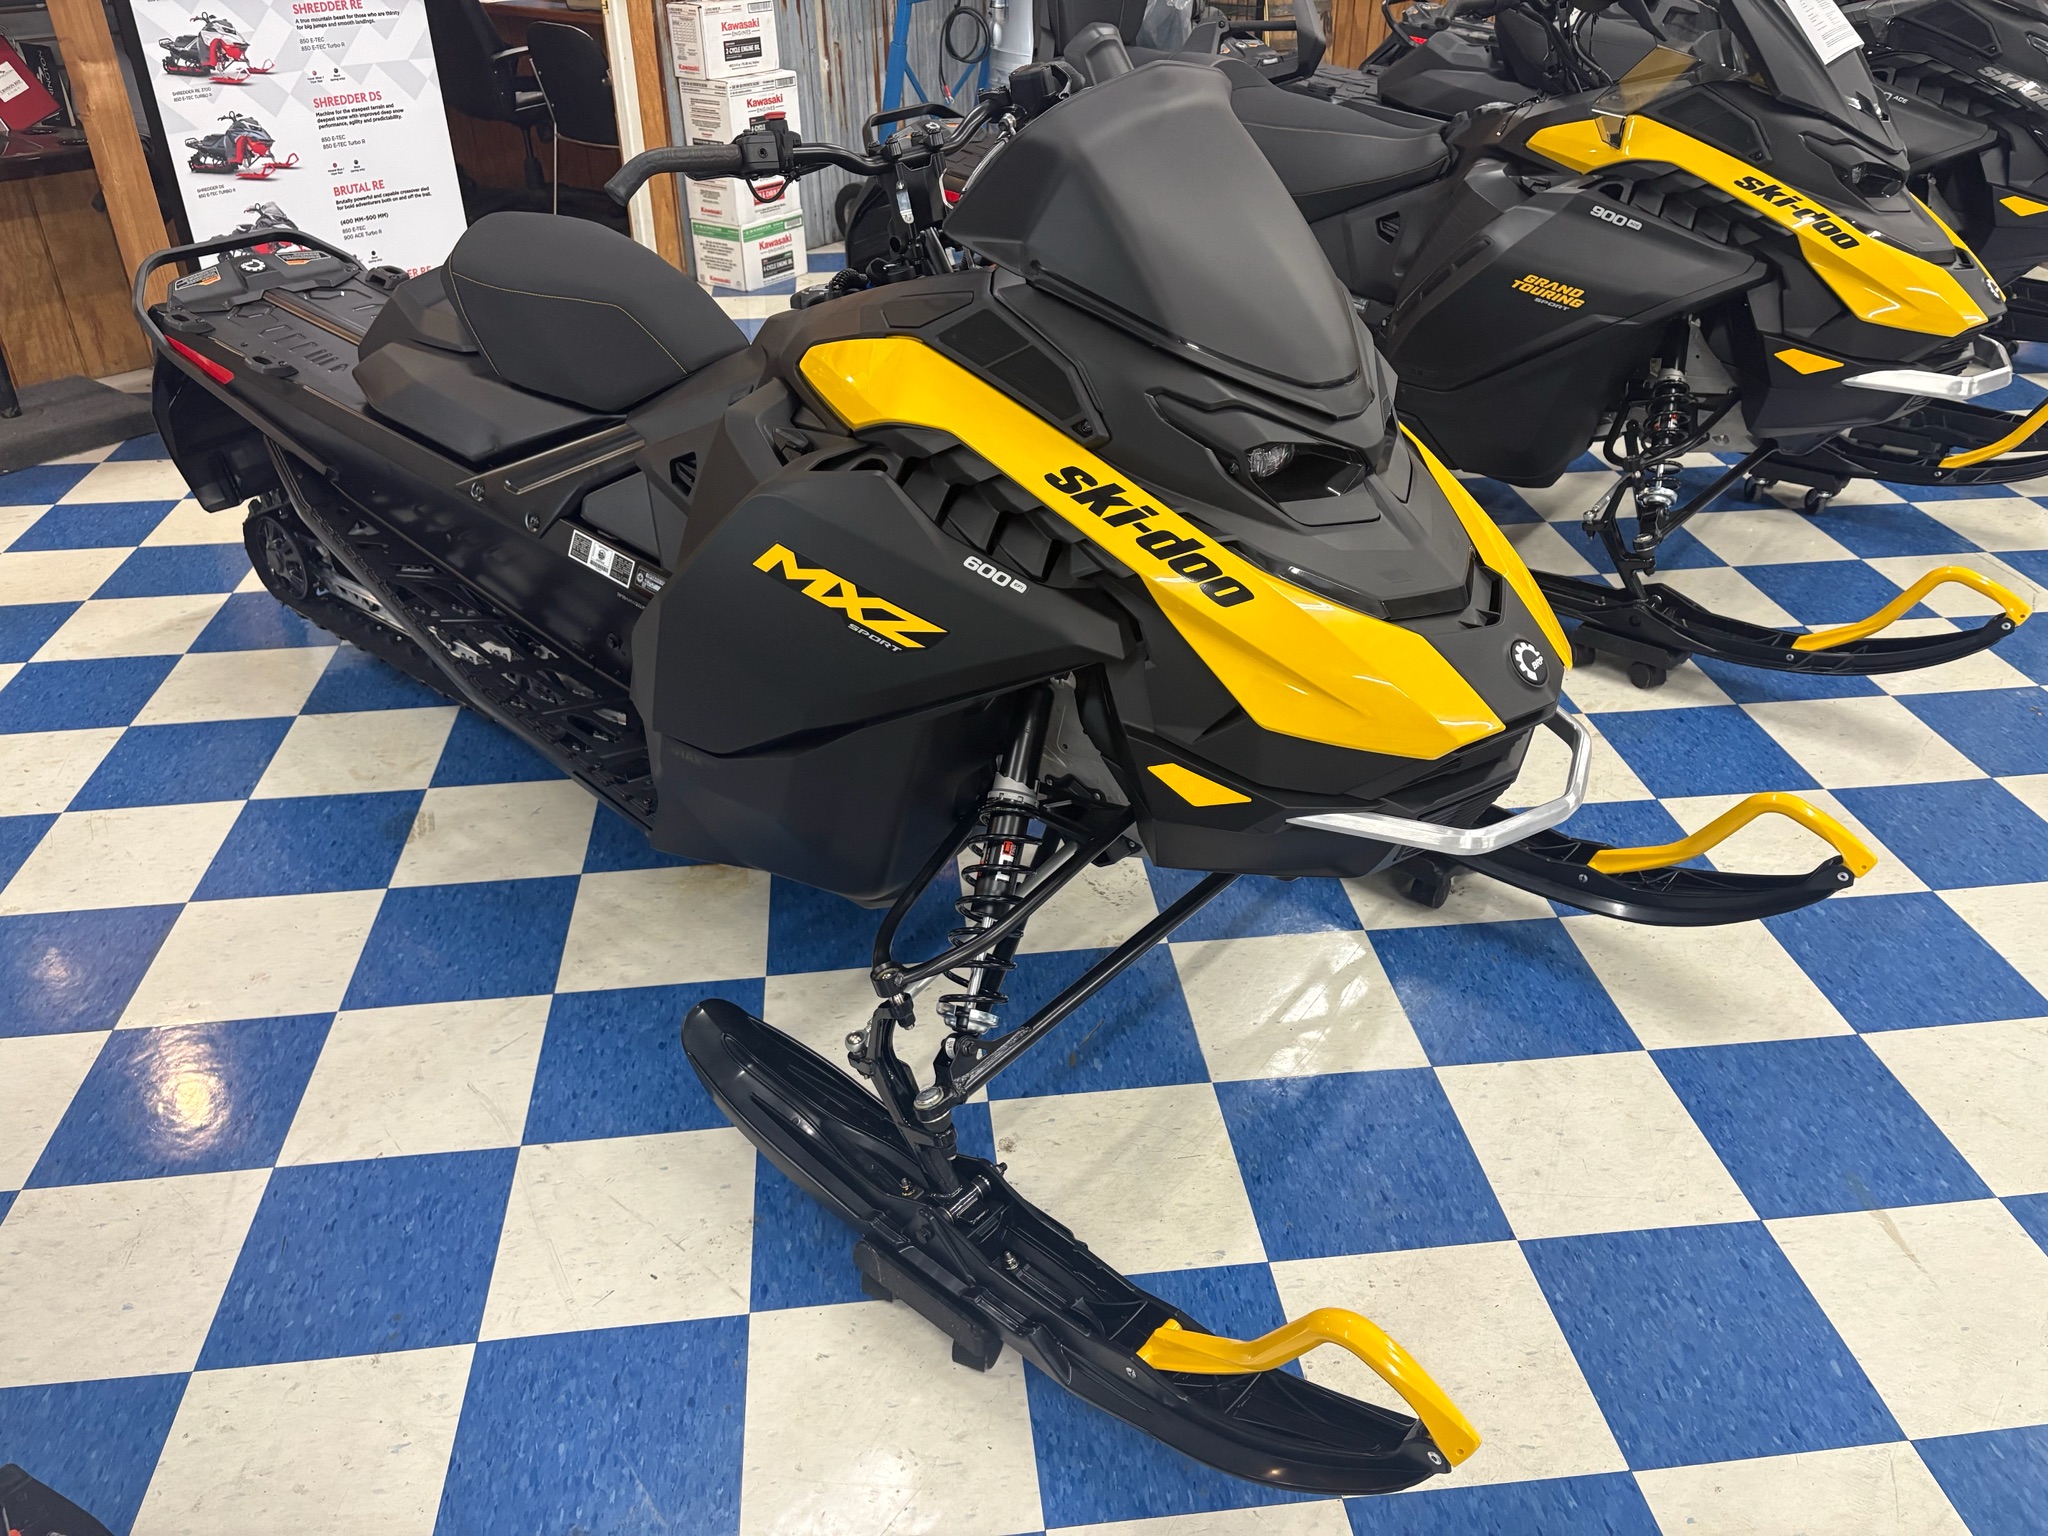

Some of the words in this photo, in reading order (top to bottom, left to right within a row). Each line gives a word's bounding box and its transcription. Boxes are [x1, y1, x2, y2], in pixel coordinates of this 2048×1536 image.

[293, 0, 348, 14] SHREDDER
[350, 0, 363, 9] RE
[721, 18, 760, 31] Kawasaki
[313, 92, 367, 108] SHREDDER
[369, 91, 382, 101] DS
[746, 93, 784, 108] Kawasaki
[1893, 95, 1909, 104] ACE
[333, 182, 371, 197] BRUTAL
[372, 179, 385, 190] RE
[1590, 205, 1627, 227] 900
[1734, 176, 1860, 249] ski-doo
[759, 233, 792, 250] Kawasaki
[1511, 279, 1585, 308] TOURING
[1523, 274, 1585, 298] GRAND
[1534, 298, 1570, 311] SPORT
[1044, 466, 1255, 608] ski-doo
[963, 556, 1011, 587] 600
[753, 543, 948, 648] MXZ
[848, 623, 902, 652] SPORT
[1531, 655, 1544, 671] BRP
